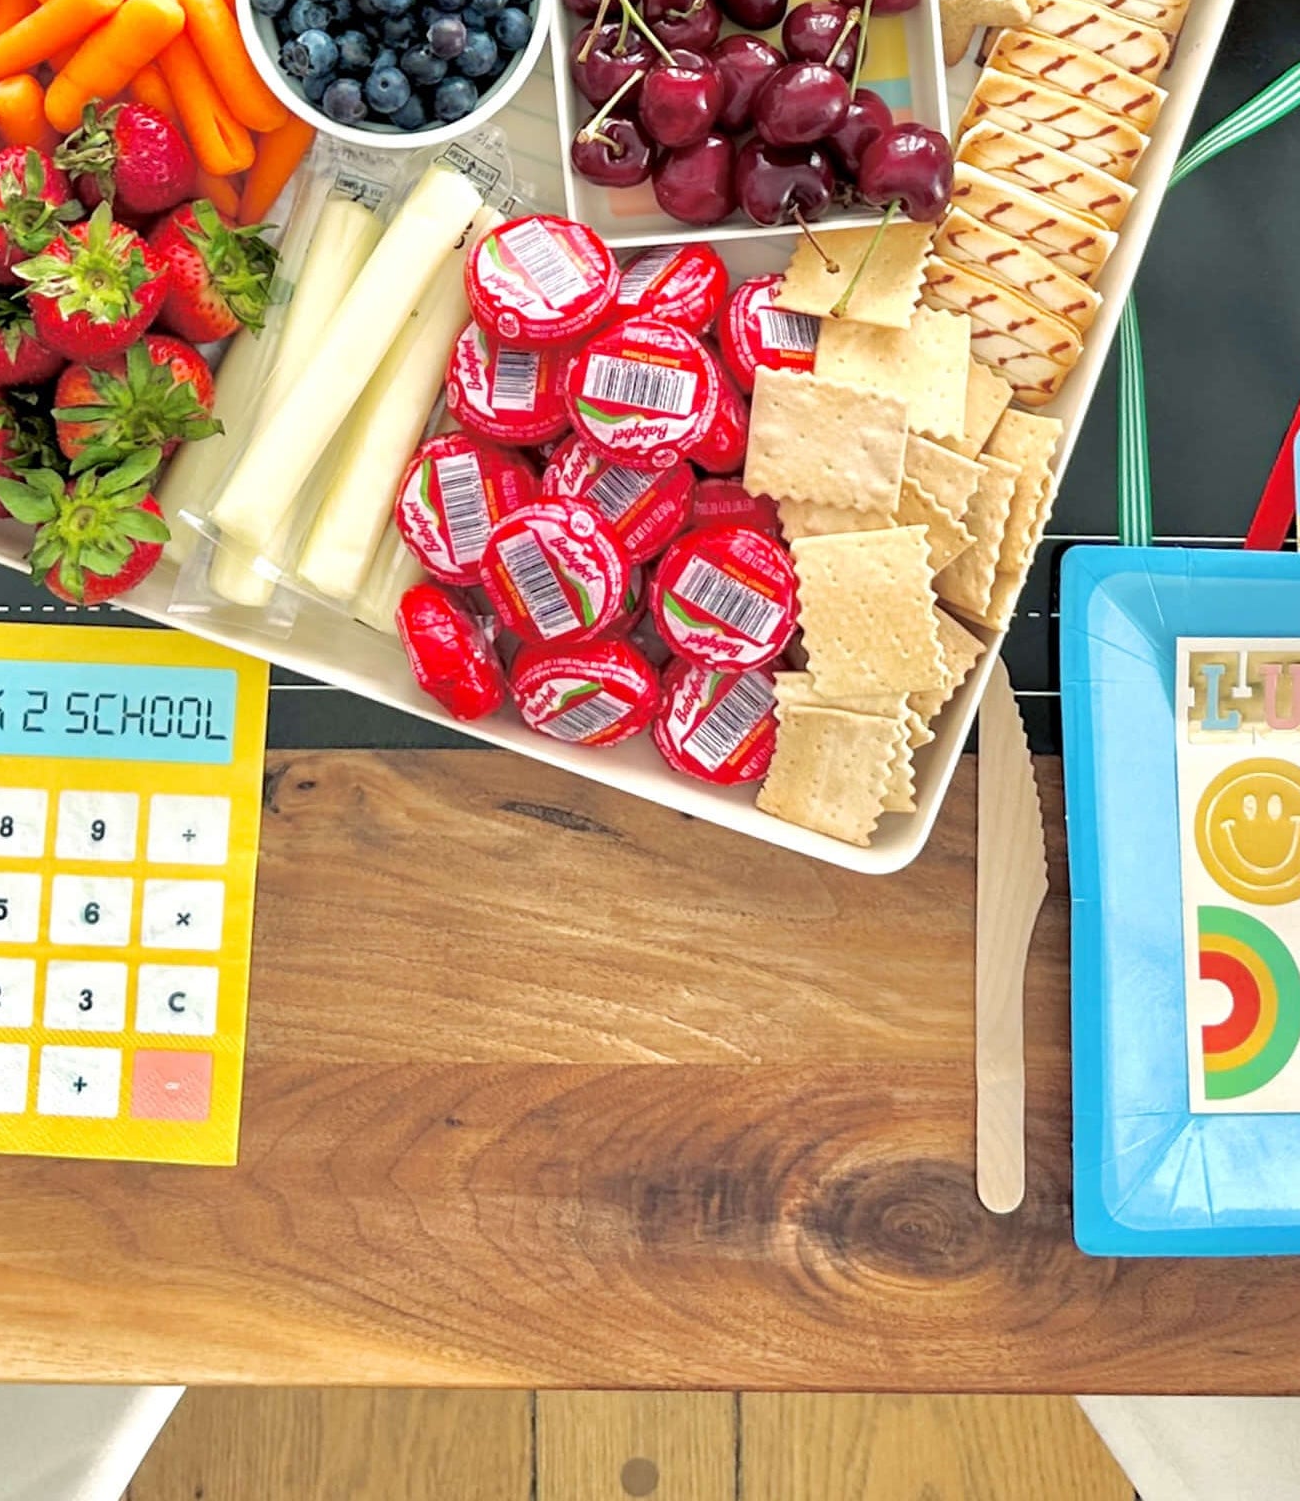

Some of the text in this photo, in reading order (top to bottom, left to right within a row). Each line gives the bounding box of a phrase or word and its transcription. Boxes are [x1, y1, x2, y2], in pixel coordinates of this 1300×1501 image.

[461, 340, 484, 391] Babybel
[611, 421, 669, 444] Babybel
[564, 449, 590, 491] Babyb
[403, 501, 442, 552] Babybel
[549, 536, 604, 583] Babybel
[683, 631, 744, 659] Babybel
[22, 691, 49, 734] 2
[64, 692, 227, 741] SCHOOL
[0, 815, 14, 838] 8
[91, 819, 106, 842] 9
[84, 902, 100, 925] 6
[78, 989, 93, 1012] 3
[168, 992, 186, 1013] C
